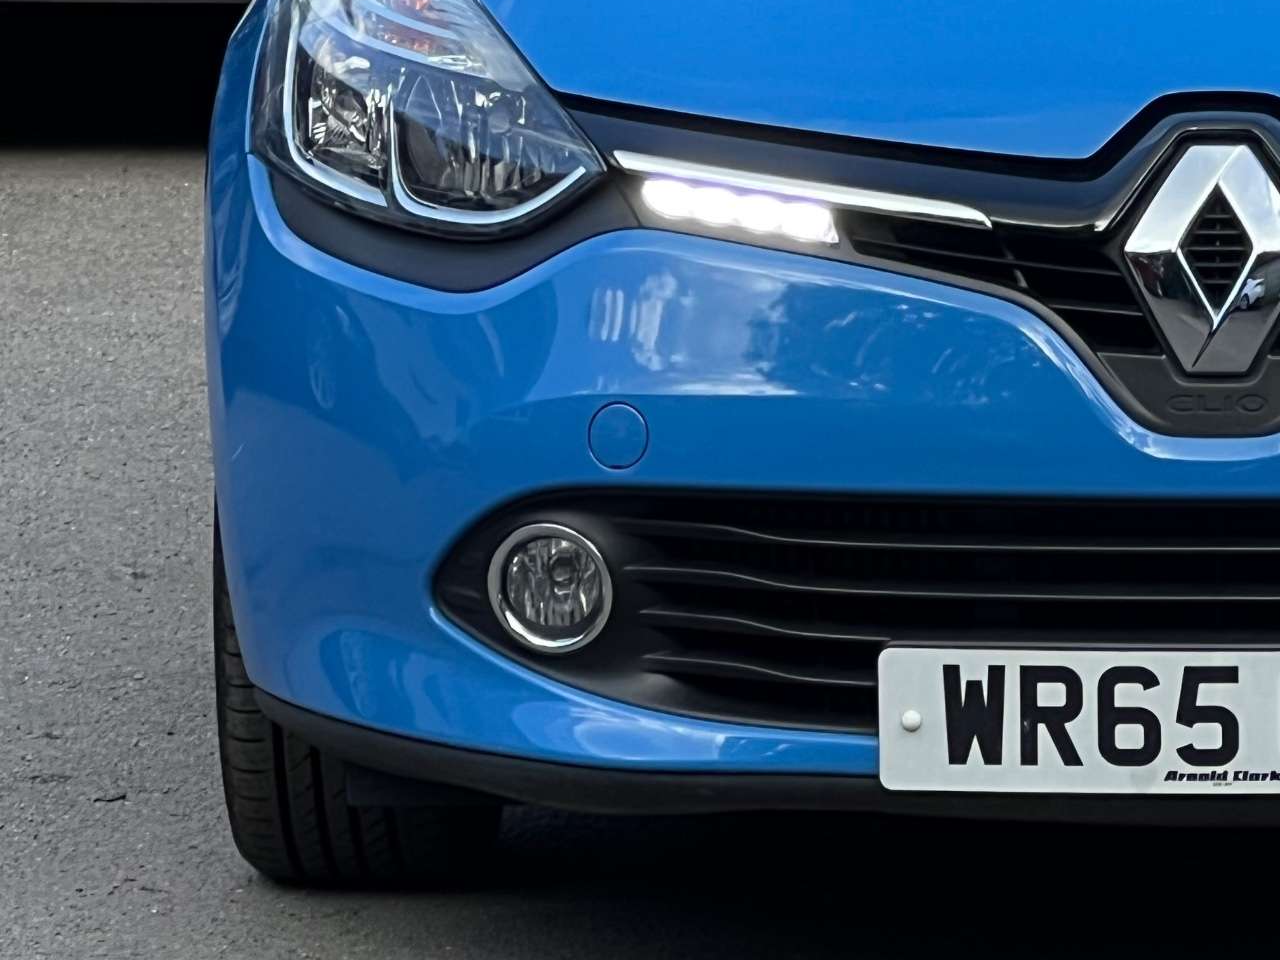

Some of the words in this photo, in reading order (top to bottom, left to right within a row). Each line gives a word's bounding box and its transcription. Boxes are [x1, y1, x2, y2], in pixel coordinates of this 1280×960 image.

[1168, 394, 1268, 413] CLIO
[942, 663, 1240, 767] WR65
[1164, 770, 1229, 782] Arnold
